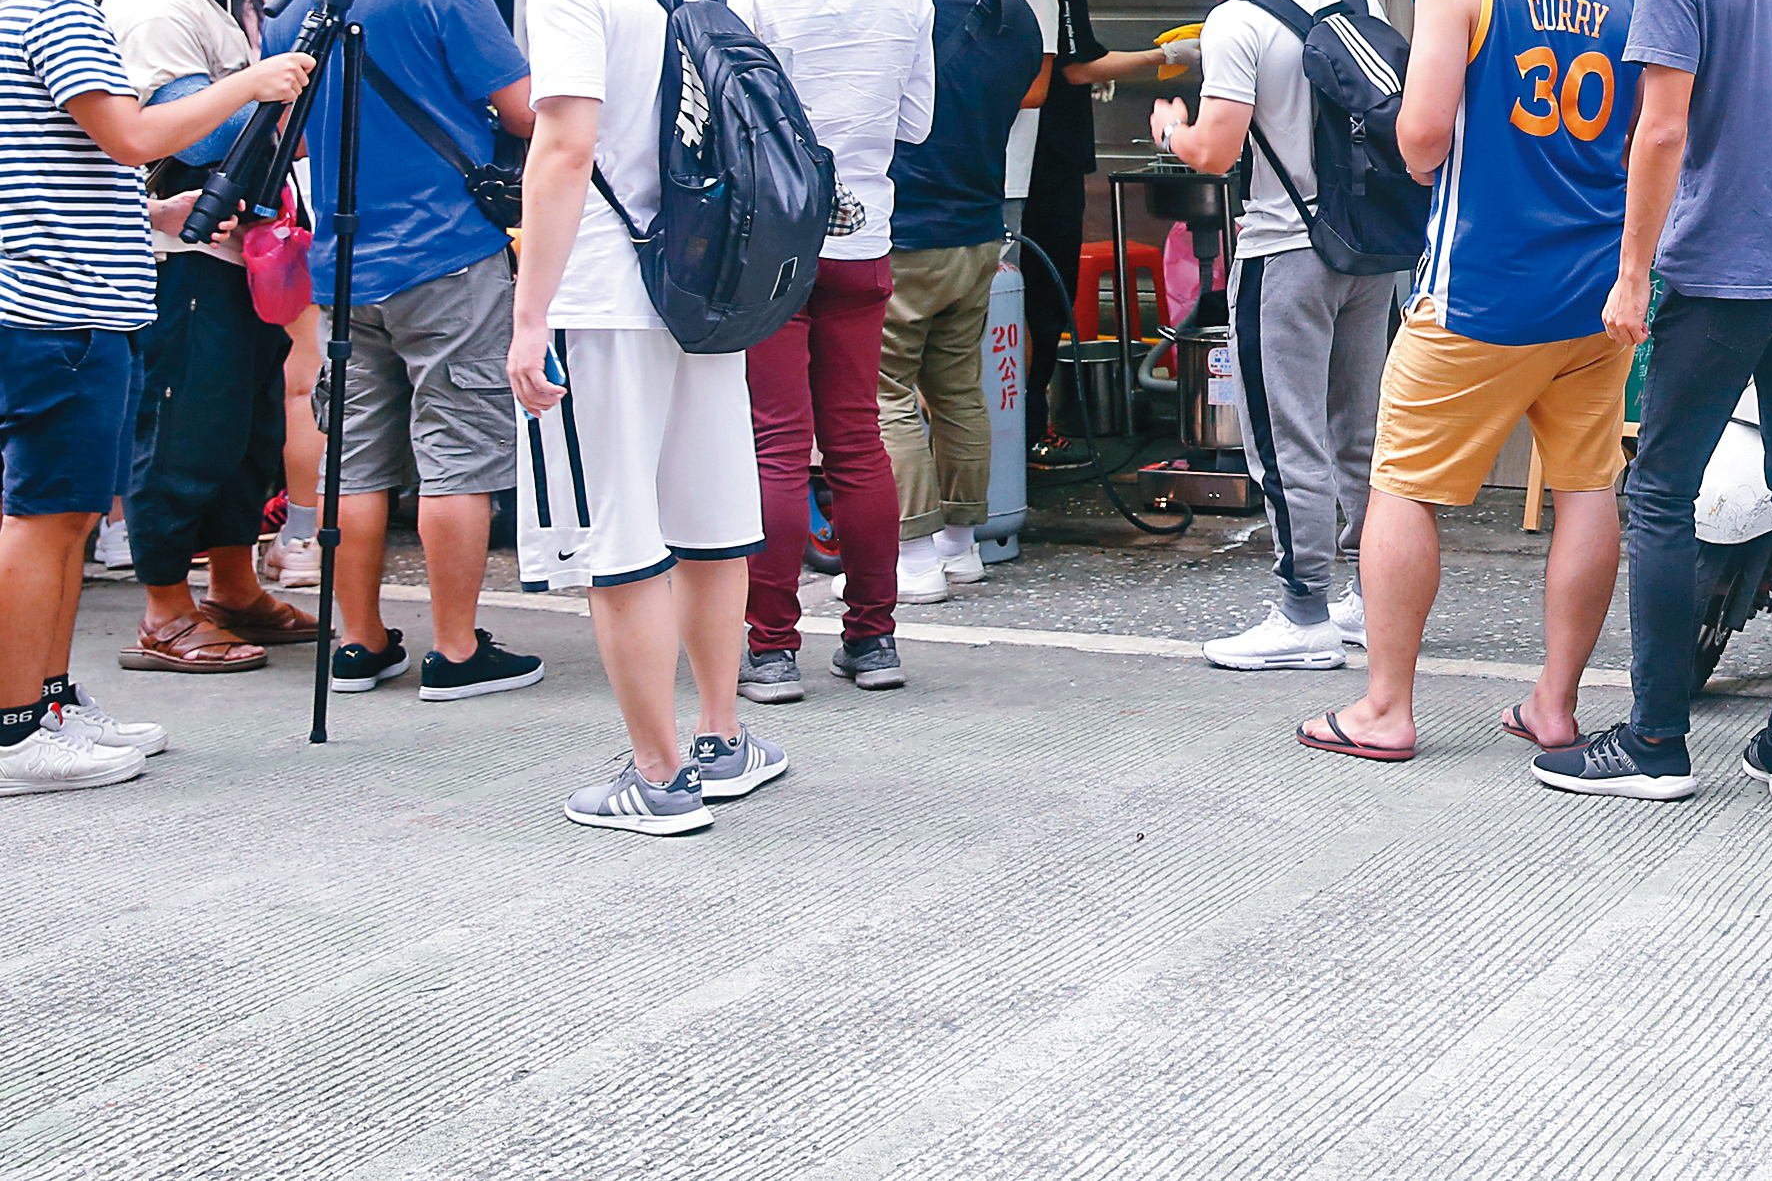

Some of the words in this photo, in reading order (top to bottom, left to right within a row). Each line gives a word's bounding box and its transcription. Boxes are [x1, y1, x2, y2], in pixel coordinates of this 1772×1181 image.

[1509, 45, 1615, 142] 30
[991, 323, 1018, 411] 20公斤
[3, 710, 33, 725] 86
